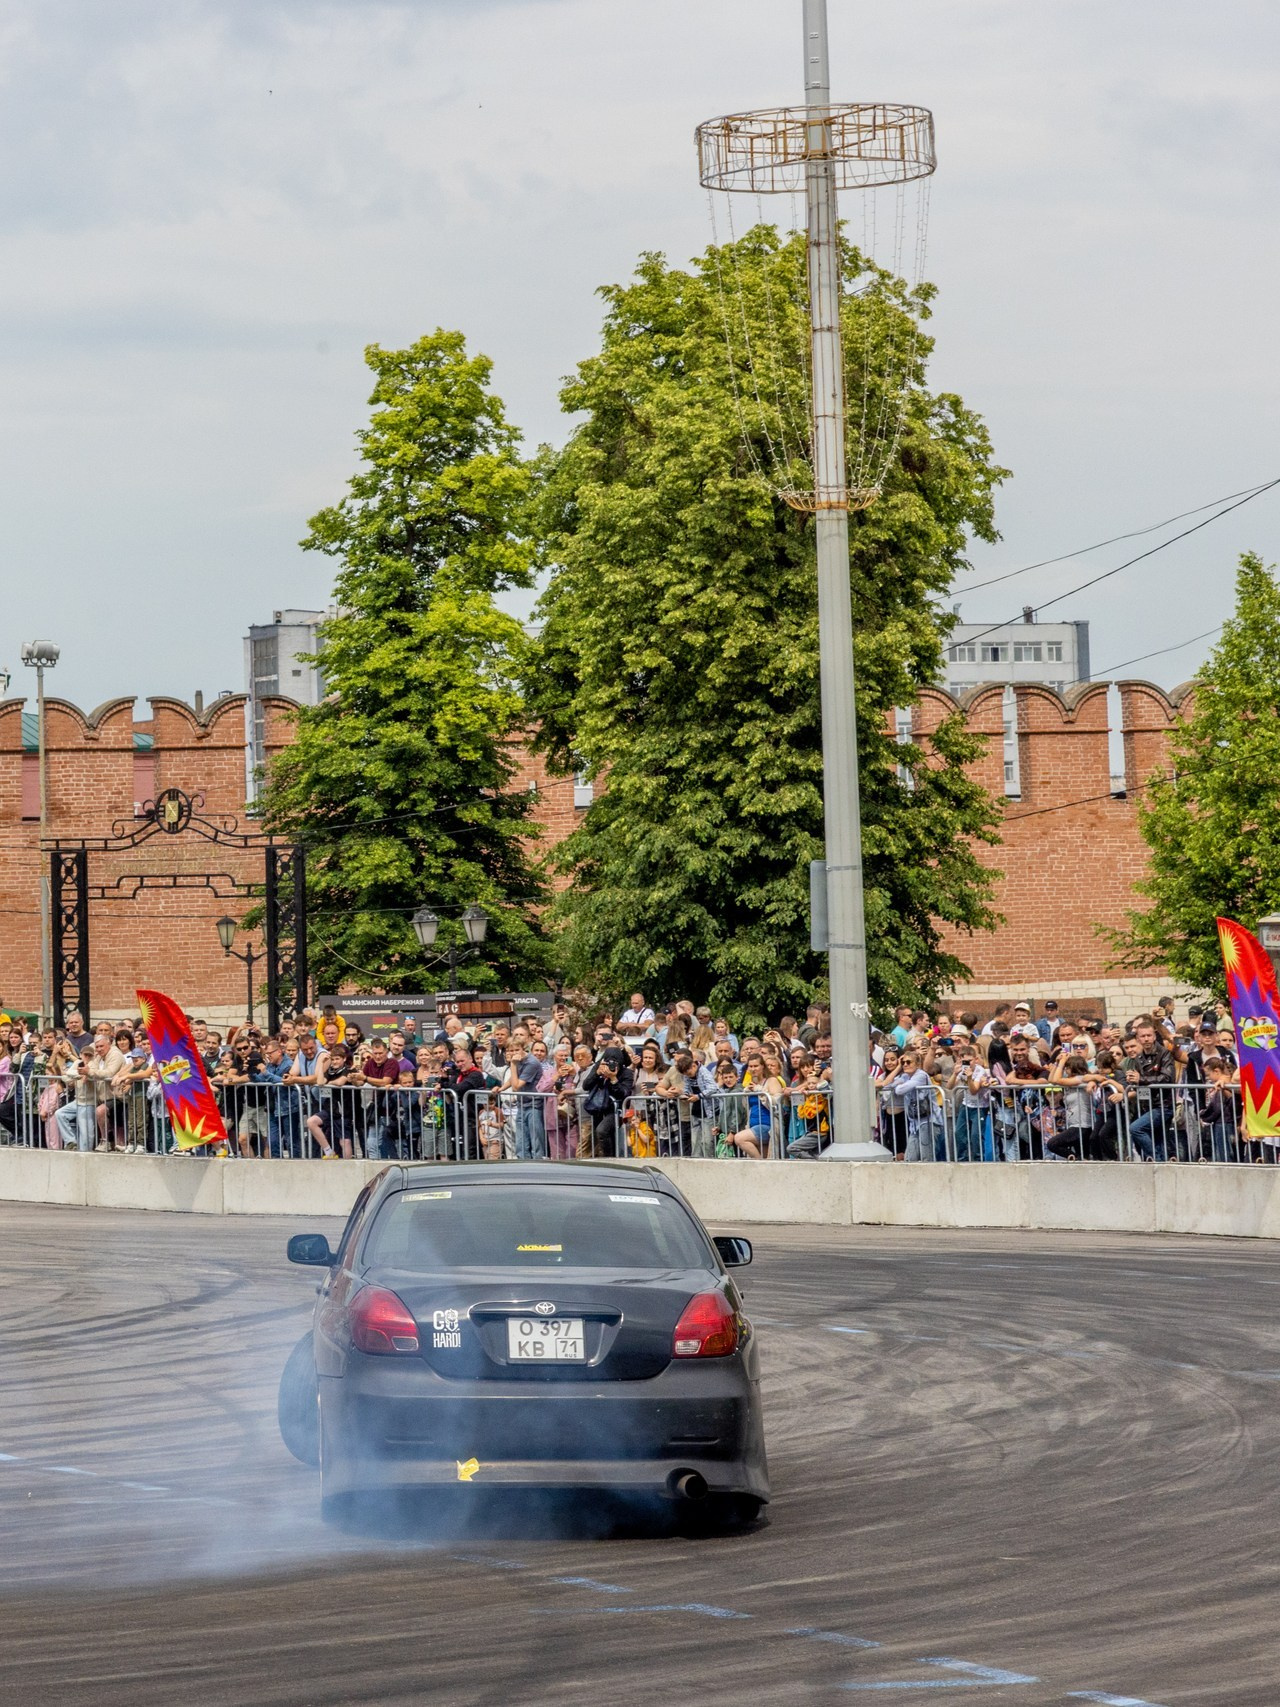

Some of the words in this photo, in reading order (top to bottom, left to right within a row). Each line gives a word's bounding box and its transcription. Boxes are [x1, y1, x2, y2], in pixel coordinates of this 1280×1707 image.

[539, 1320, 572, 1337] 397
[433, 1333, 461, 1348] HARD!
[560, 1341, 578, 1353] 71
